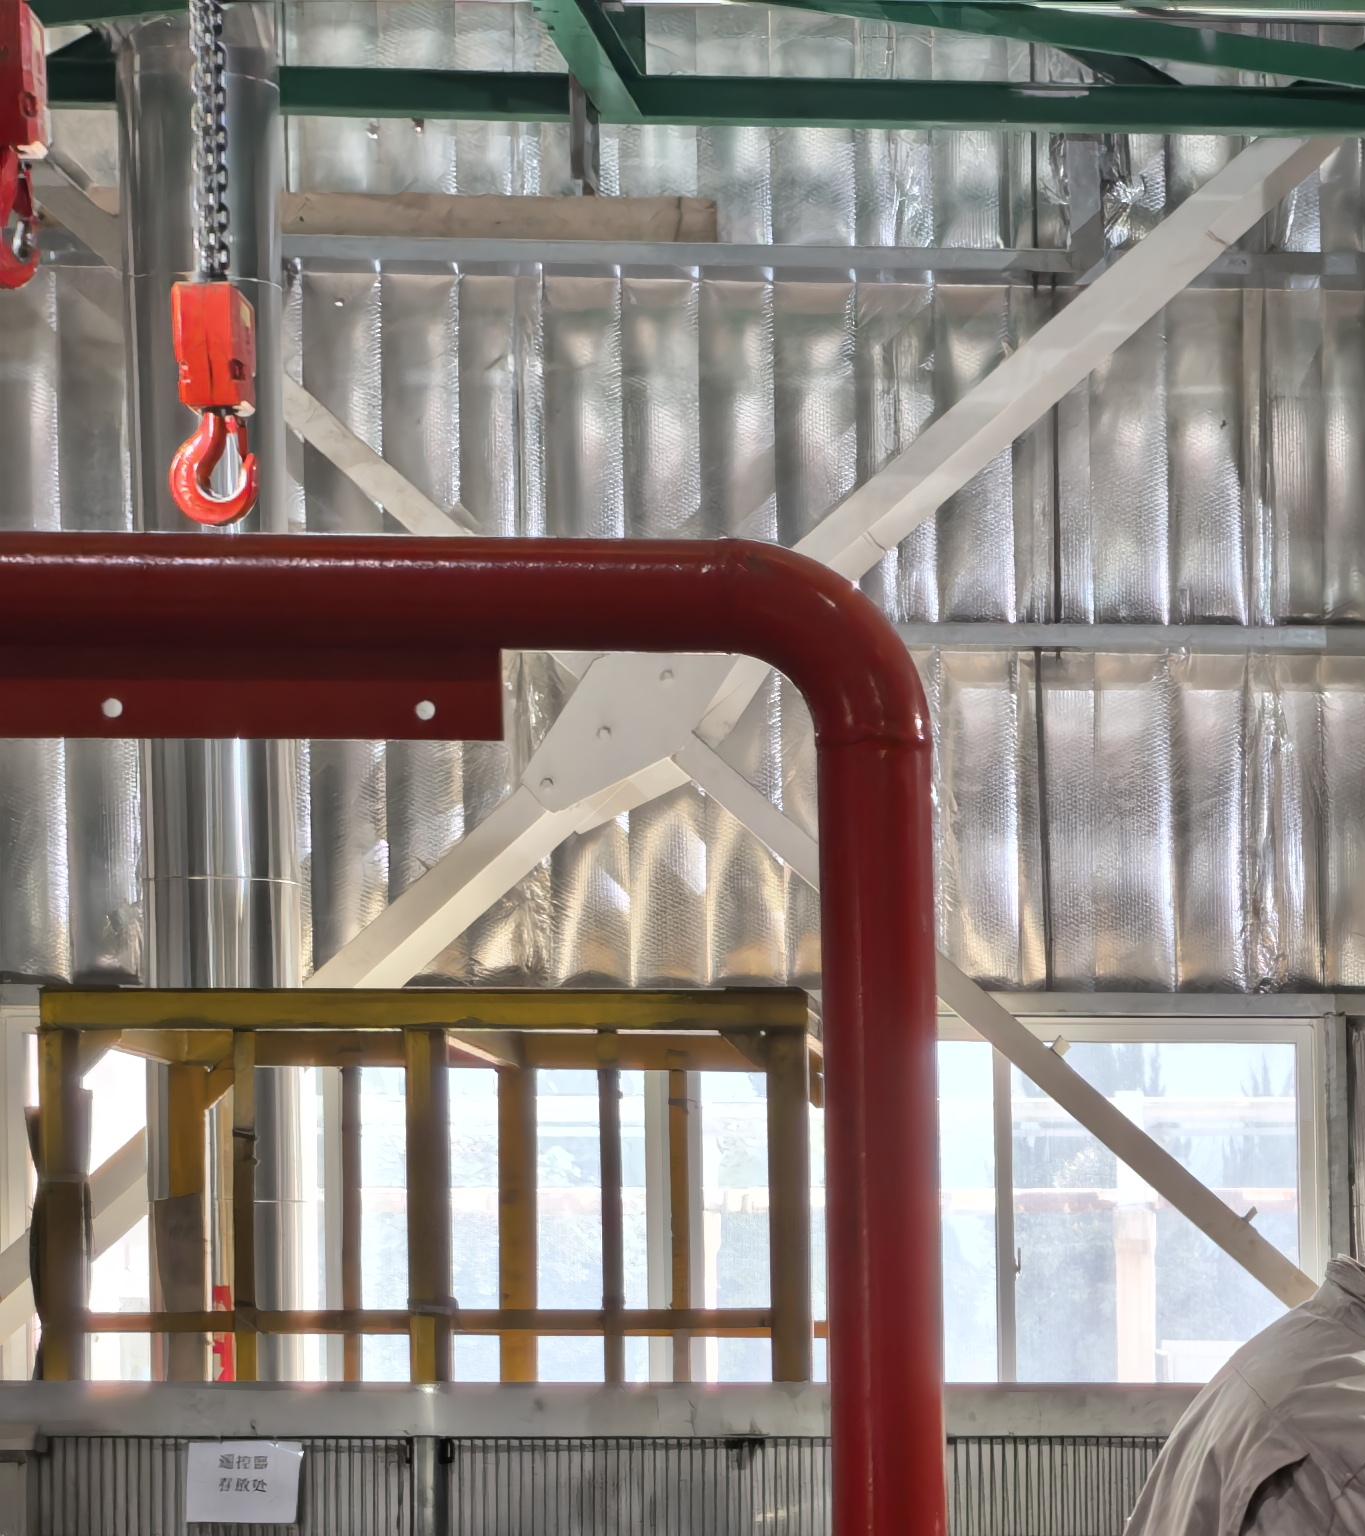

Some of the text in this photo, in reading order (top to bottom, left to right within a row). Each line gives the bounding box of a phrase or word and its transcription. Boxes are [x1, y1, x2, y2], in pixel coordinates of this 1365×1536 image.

[218, 1453, 268, 1470] 遥控器
[218, 1476, 268, 1493] 存放处
